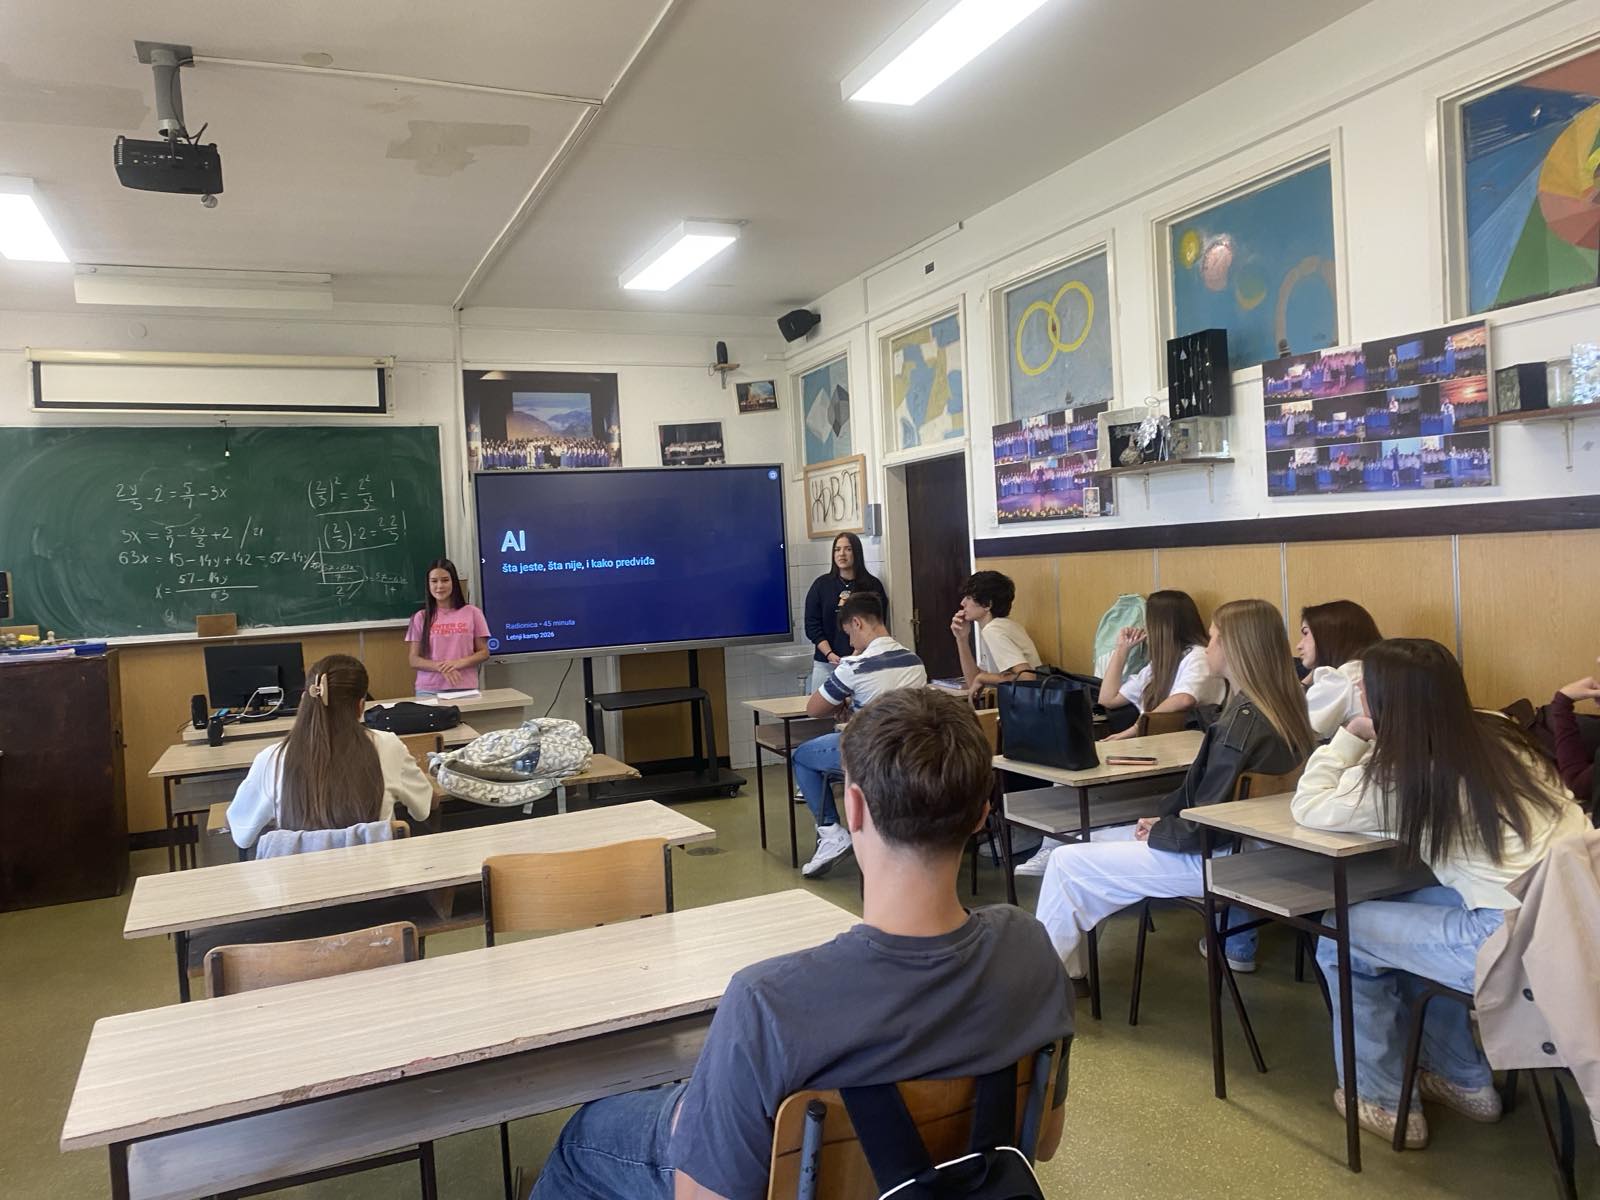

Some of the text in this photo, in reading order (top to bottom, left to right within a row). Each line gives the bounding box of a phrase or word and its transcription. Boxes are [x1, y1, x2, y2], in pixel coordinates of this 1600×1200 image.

[501, 530, 526, 552] AI
[118, 550, 150, 565] 63x
[502, 563, 518, 573] šta
[519, 561, 546, 574] jeste,
[548, 560, 563, 571] šta
[565, 559, 585, 571] nije,
[591, 557, 614, 568] kako
[615, 556, 655, 568] predviđa
[552, 619, 576, 627] minuta
